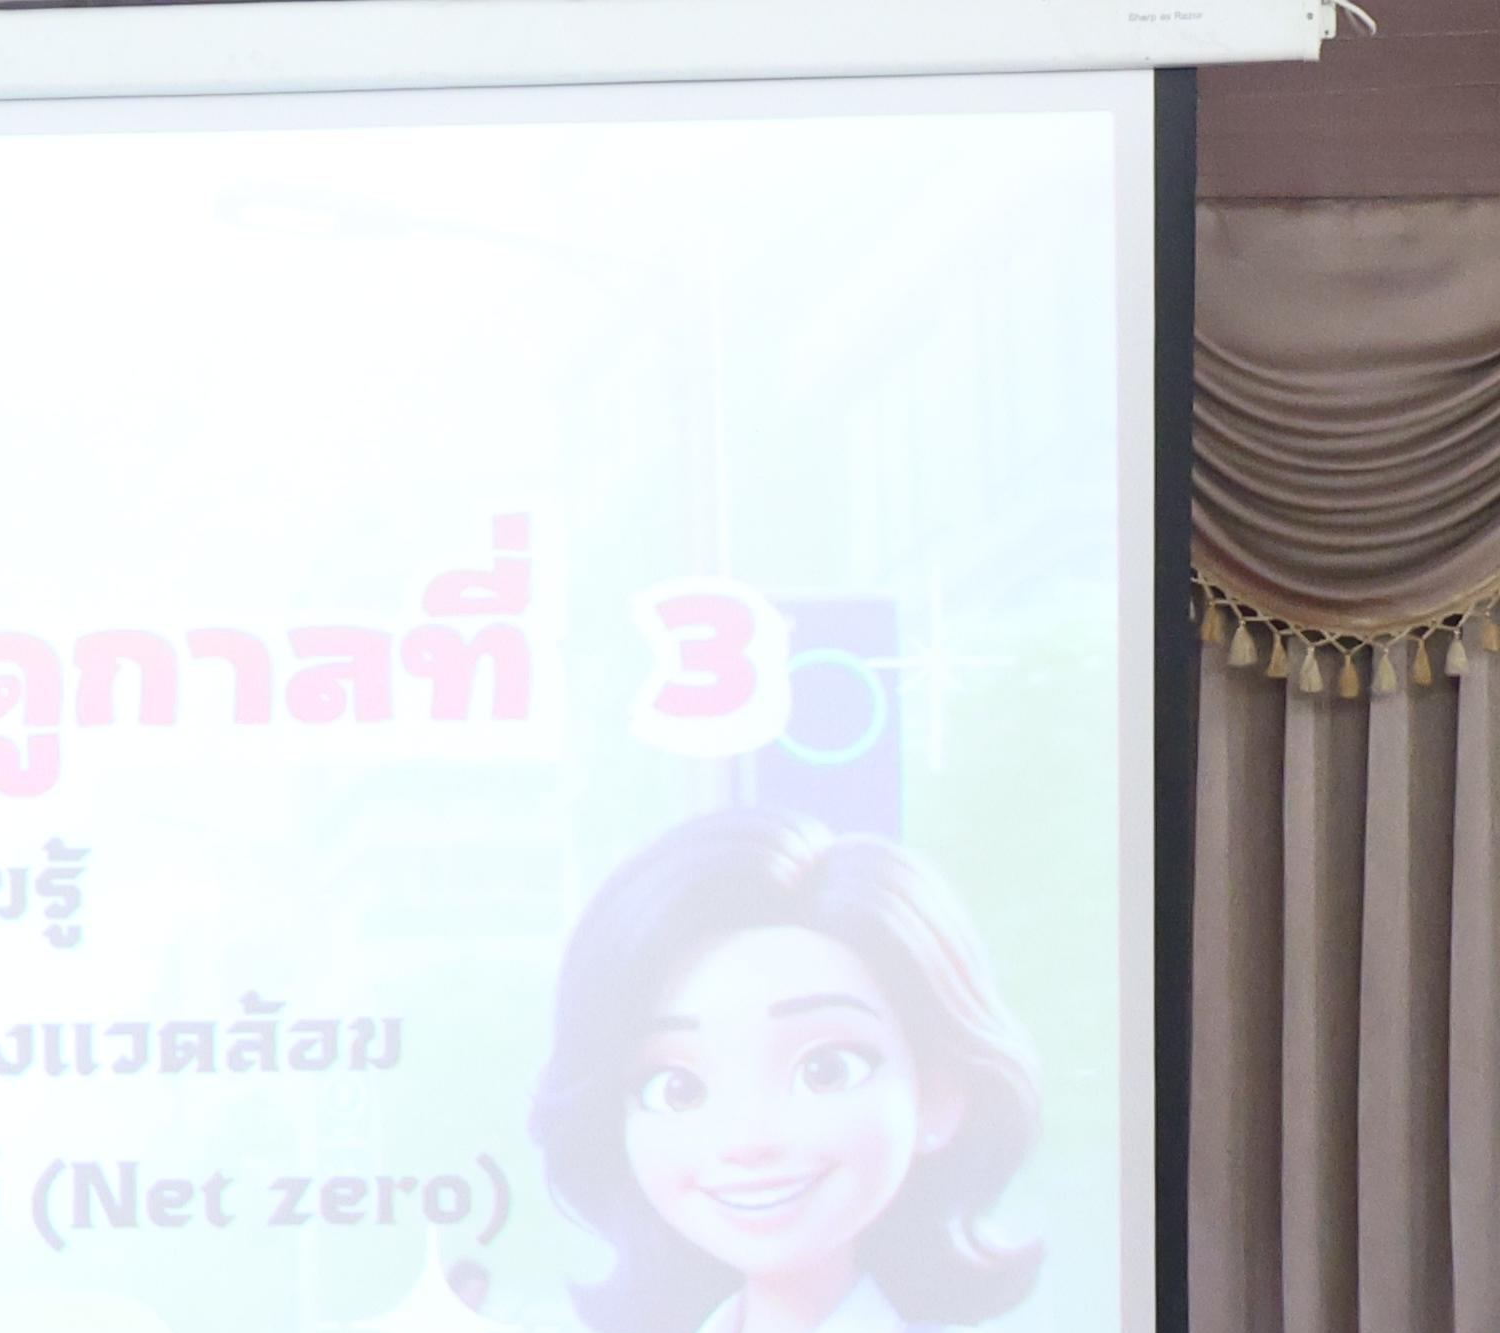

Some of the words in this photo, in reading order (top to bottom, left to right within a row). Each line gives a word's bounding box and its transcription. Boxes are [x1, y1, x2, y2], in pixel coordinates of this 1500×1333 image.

[652, 593, 757, 719] 3
[30, 1157, 236, 1253] (Net
[266, 1151, 513, 1247] zero)
